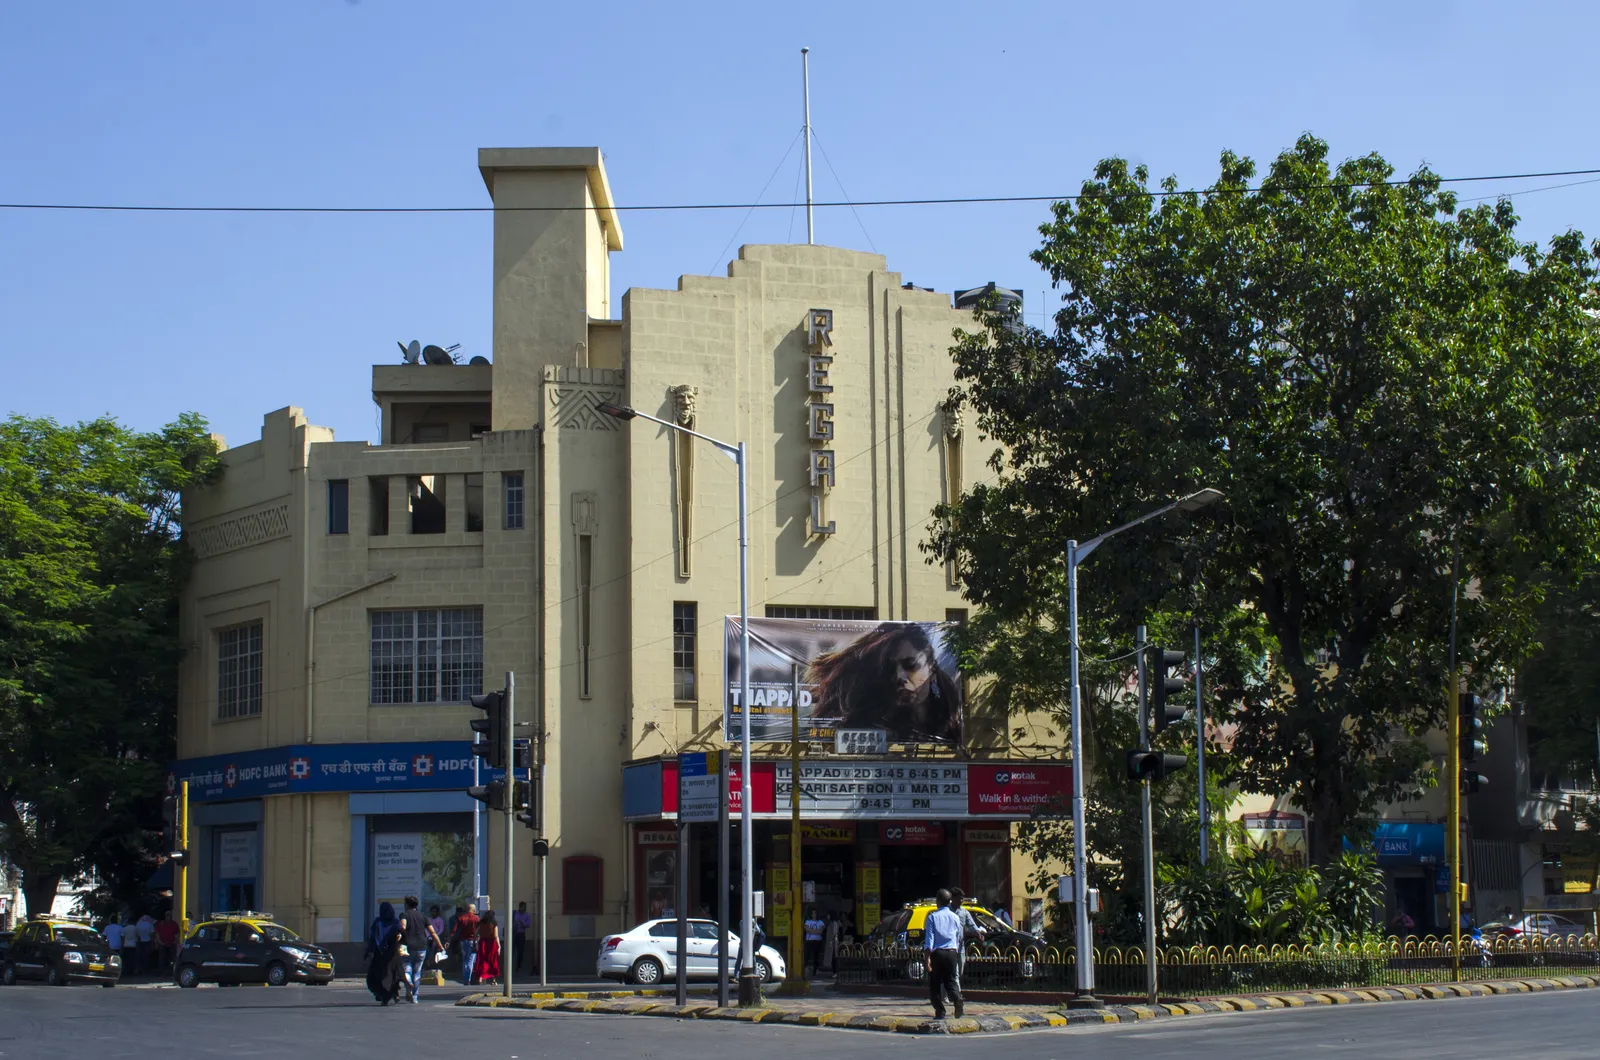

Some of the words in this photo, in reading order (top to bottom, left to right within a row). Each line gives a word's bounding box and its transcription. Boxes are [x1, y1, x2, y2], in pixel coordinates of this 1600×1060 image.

[808, 308, 836, 534] REGAL
[819, 729, 835, 738] CINE
[239, 767, 261, 781] HDFC
[263, 763, 287, 777] BANK
[777, 768, 841, 778] THAPPAD
[854, 769, 871, 779] 2D
[874, 768, 904, 778] 3:45
[909, 768, 939, 778] 6:45
[943, 769, 961, 779] PM
[1010, 772, 1036, 780] kotak
[776, 783, 827, 793] KESARI
[830, 784, 893, 793] SAFFRON
[911, 783, 938, 793] MAR
[943, 784, 961, 793] 2D
[979, 794, 1001, 803] Walk
[1003, 794, 1012, 803] in
[1013, 794, 1021, 803] &
[1022, 794, 1048, 803] withd
[861, 799, 891, 808] 9:45
[912, 799, 930, 808] PM
[904, 825, 926, 833] kotak
[969, 832, 1003, 840] REGAL
[1384, 841, 1408, 851] BANK
